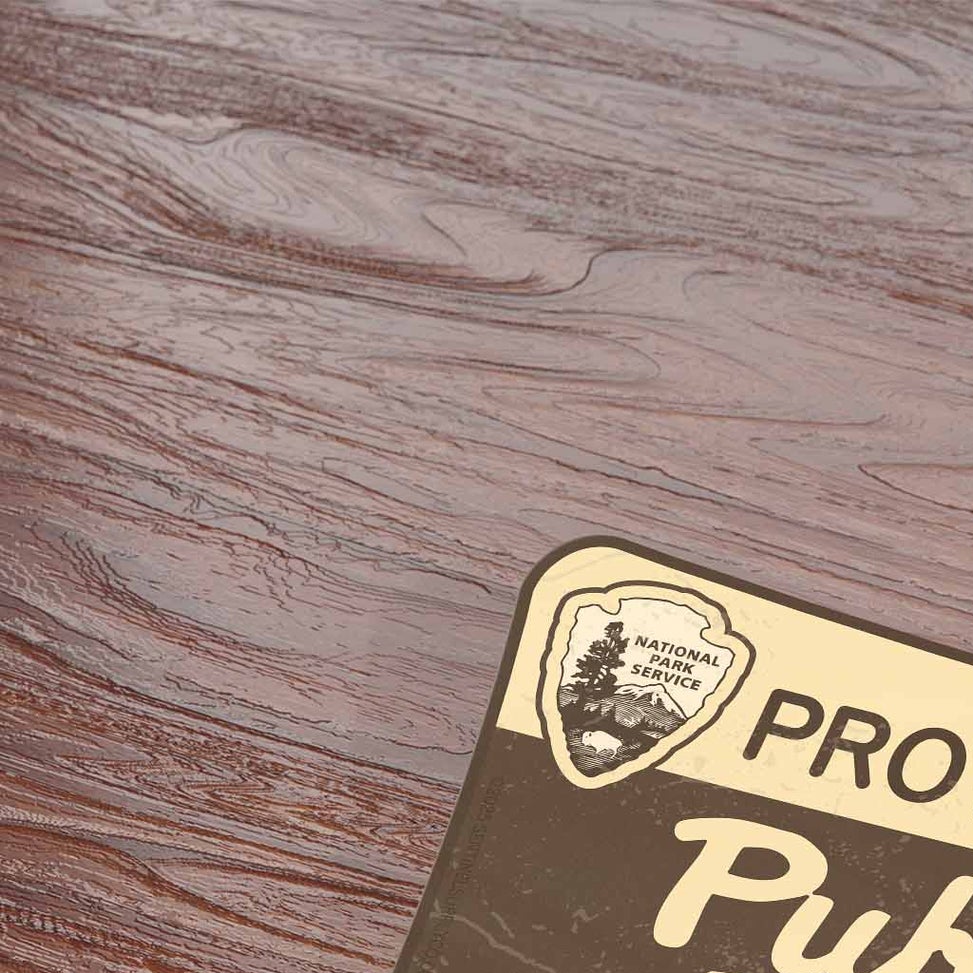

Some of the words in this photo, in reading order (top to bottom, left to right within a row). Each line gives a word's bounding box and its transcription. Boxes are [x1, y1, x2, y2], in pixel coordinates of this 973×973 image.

[634, 635, 720, 668] NATIONAL
[648, 653, 696, 675] PARK
[630, 663, 702, 692] SERVICE
